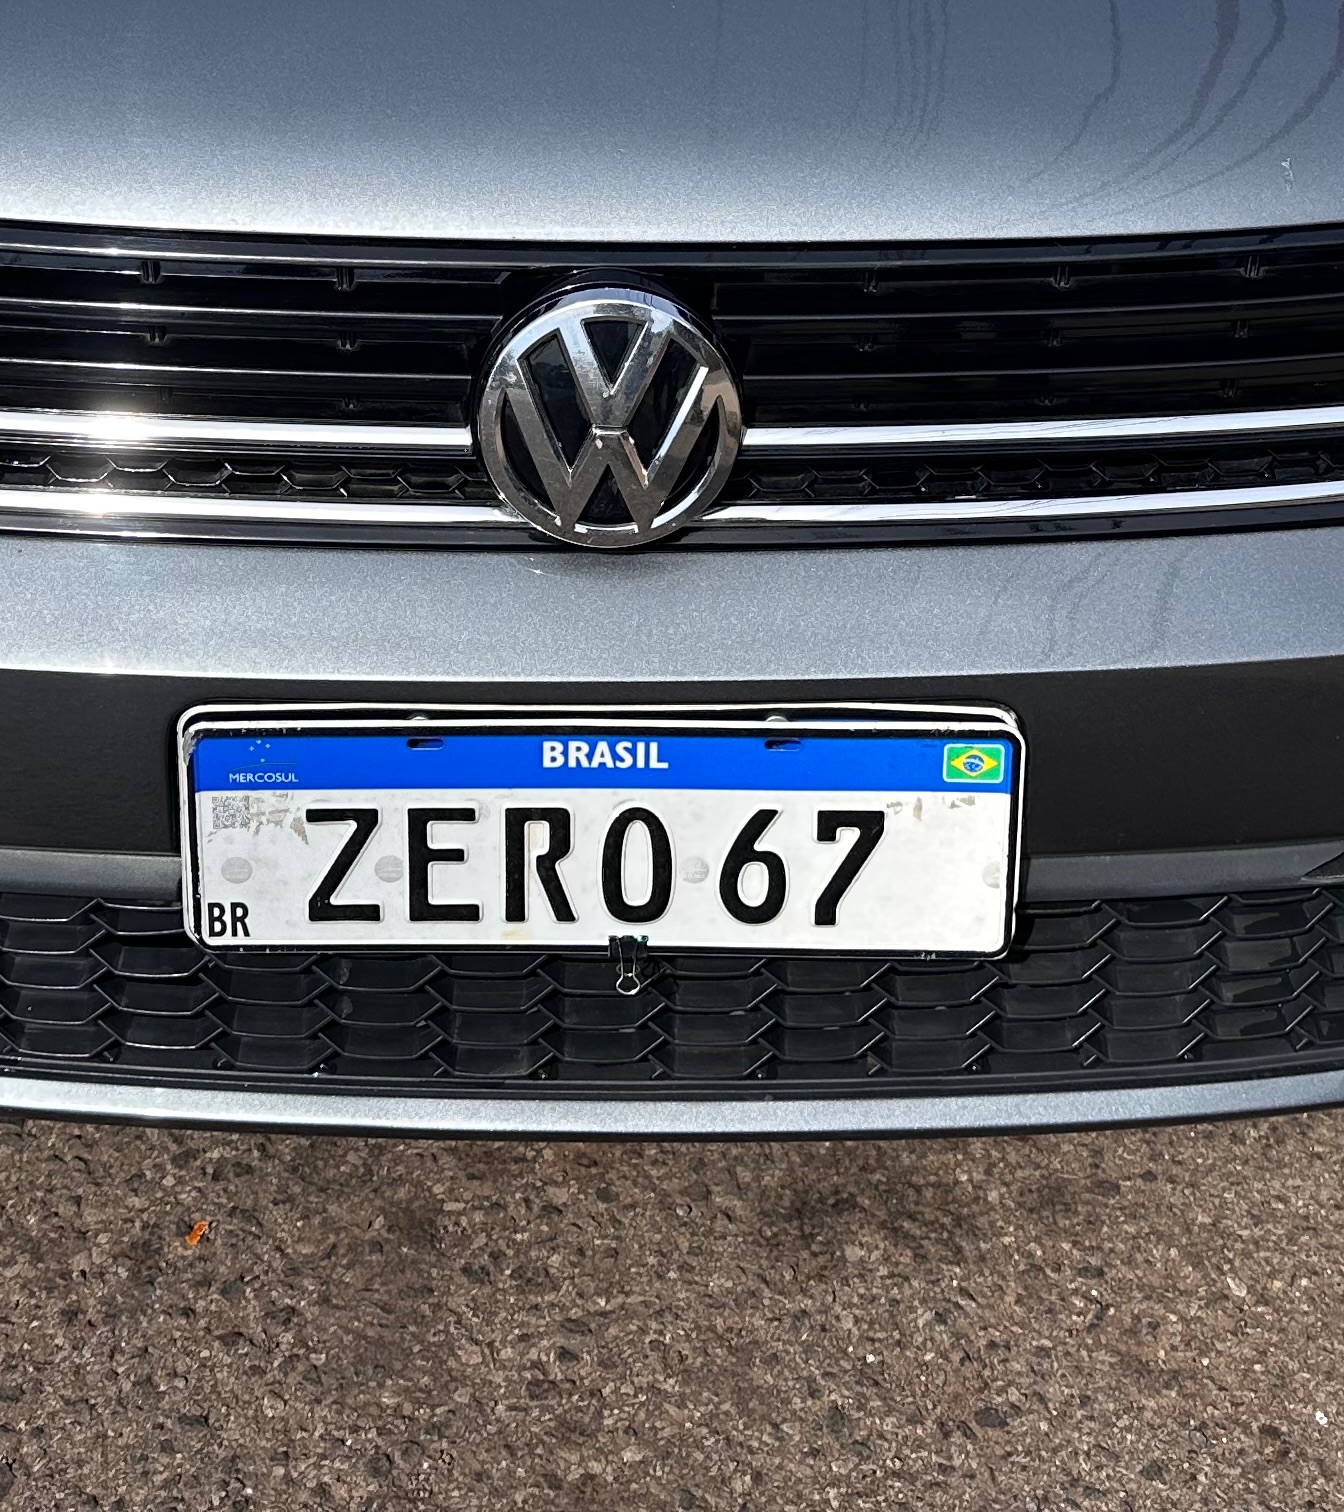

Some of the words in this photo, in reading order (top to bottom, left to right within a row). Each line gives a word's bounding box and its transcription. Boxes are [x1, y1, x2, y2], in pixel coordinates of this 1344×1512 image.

[542, 740, 668, 769] BRASIL
[228, 772, 299, 783] MERCOSUL
[306, 807, 673, 924] ZERO
[719, 809, 885, 926] 67
[207, 902, 251, 938] BR
